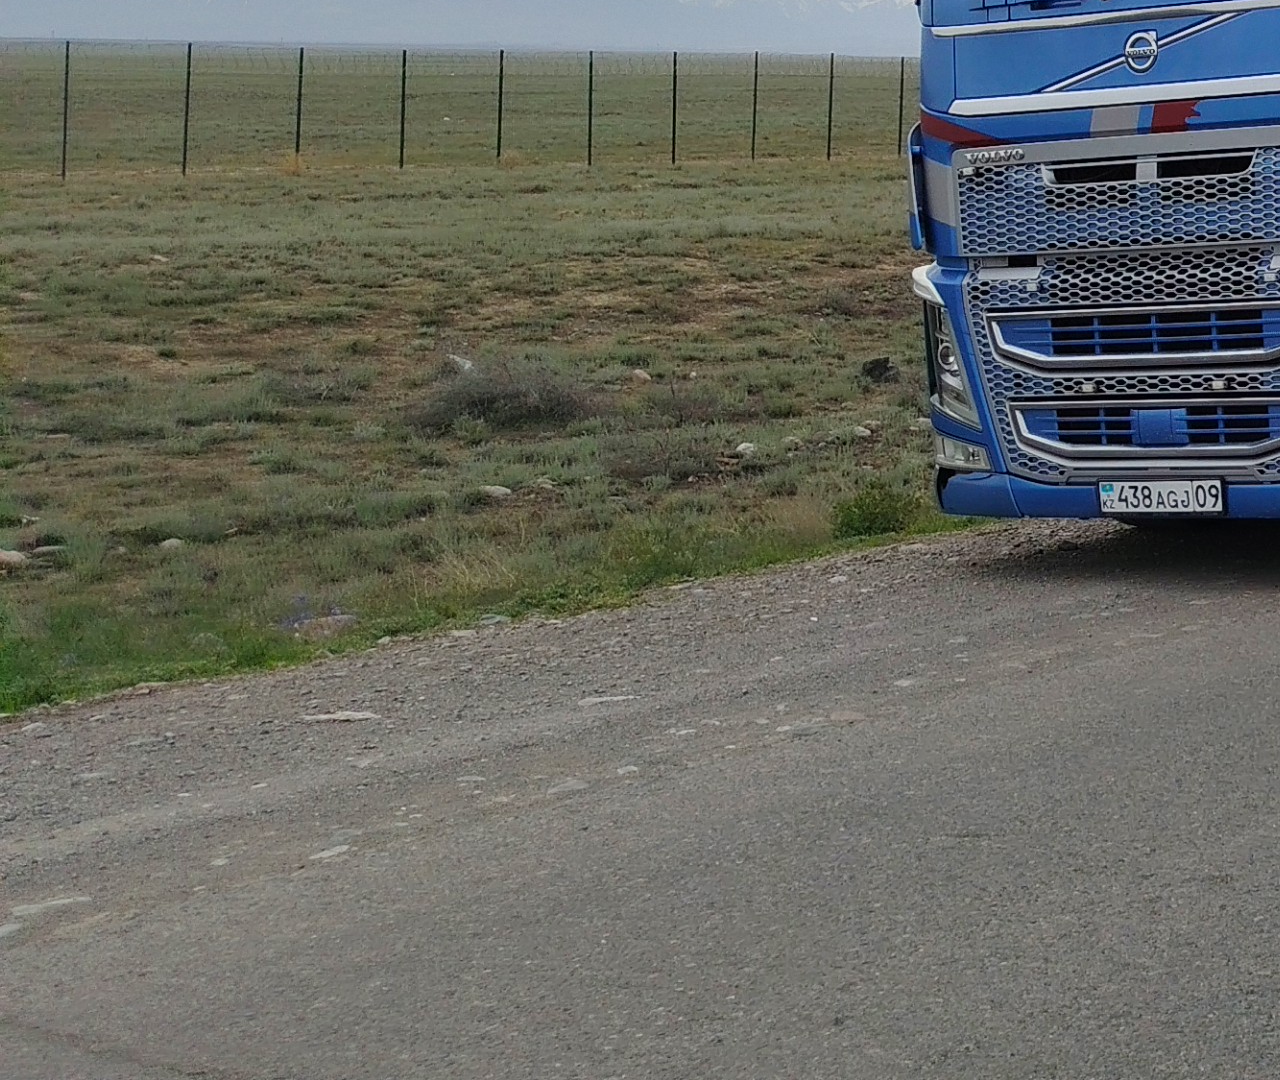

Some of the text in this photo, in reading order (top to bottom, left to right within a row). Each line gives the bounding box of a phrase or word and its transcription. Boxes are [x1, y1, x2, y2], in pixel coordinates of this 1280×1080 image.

[1127, 48, 1156, 56] VOLVO
[964, 148, 1025, 165] VOLVO
[1102, 484, 1219, 509] KZ 438 AGJ 09
